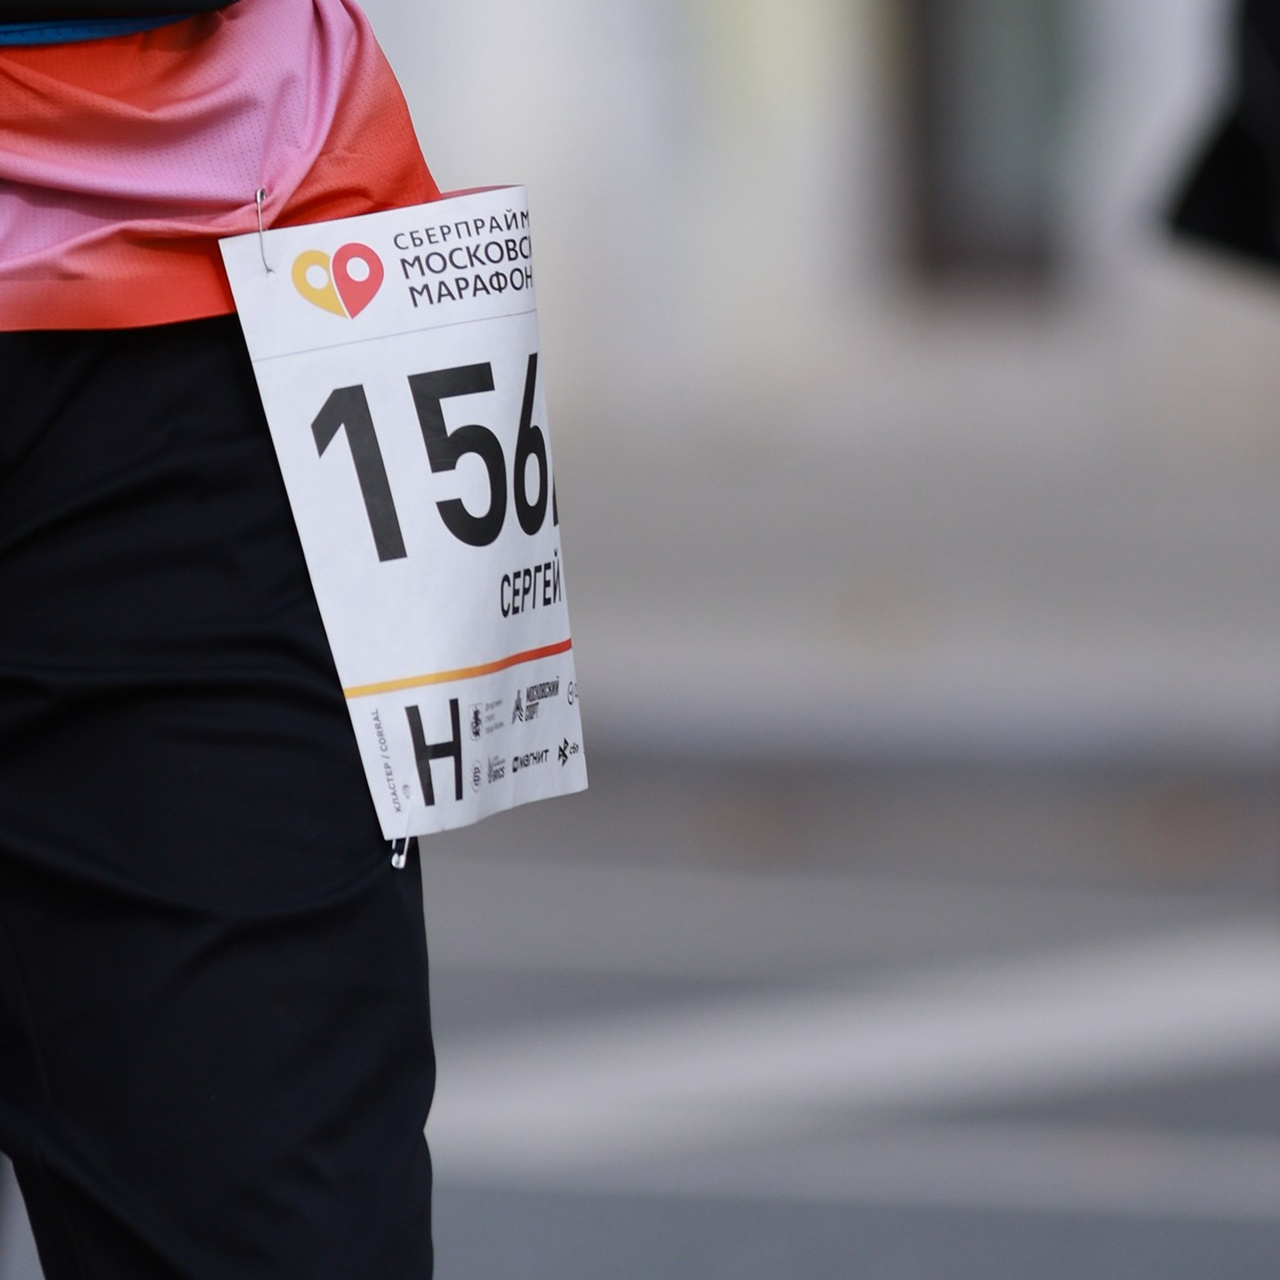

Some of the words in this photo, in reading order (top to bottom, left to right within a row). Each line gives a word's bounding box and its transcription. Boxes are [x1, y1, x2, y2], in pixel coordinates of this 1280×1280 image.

[393, 208, 530, 251] СБЕРПРАЙМ
[409, 270, 534, 308] МАРАФОН
[310, 352, 559, 563] 156
[500, 548, 561, 618] СЕРГЕЙ
[371, 707, 388, 752] CORRAL
